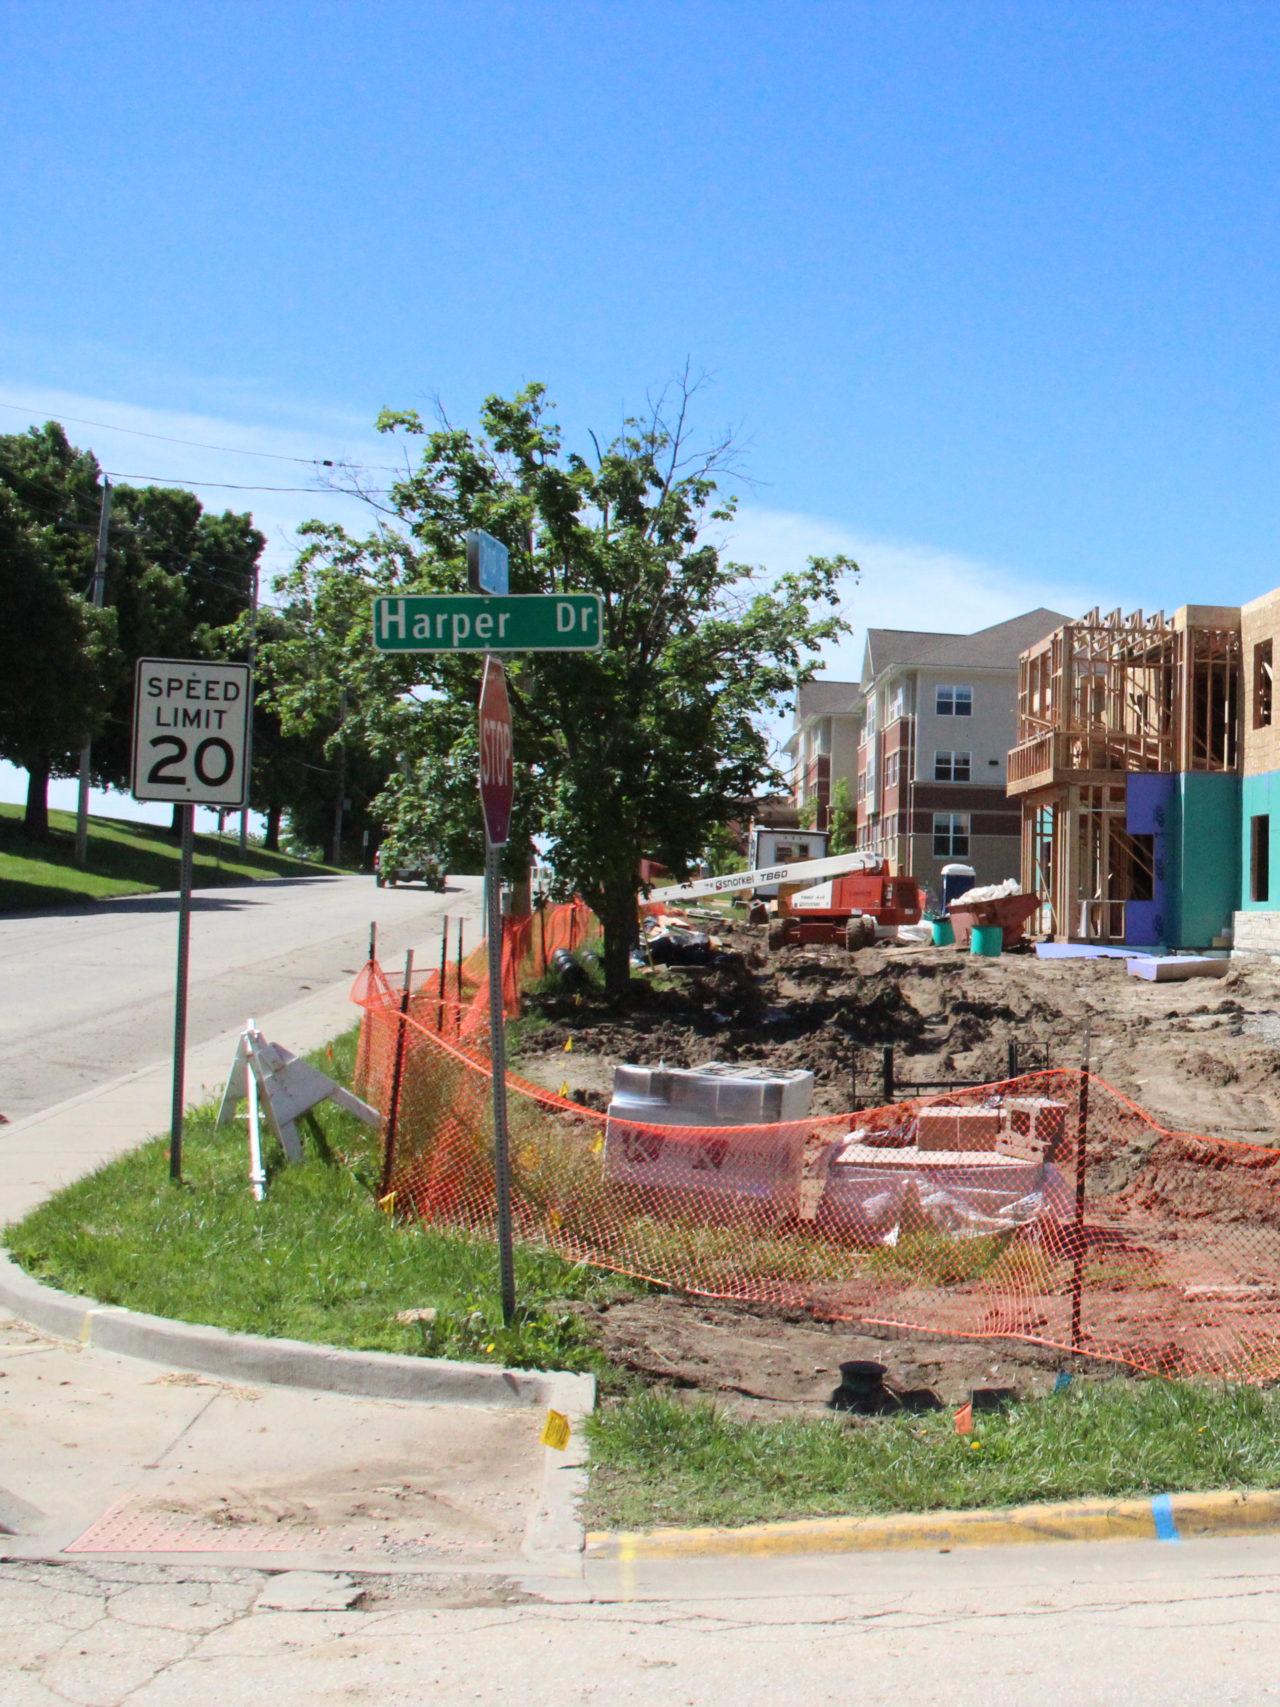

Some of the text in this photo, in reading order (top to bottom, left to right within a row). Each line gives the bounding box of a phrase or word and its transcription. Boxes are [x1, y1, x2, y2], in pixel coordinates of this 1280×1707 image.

[381, 600, 593, 647] Harper Dr
[147, 677, 240, 701] SPEED
[156, 706, 227, 730] LIMIT
[147, 735, 235, 787] 20
[483, 718, 511, 786] STOP
[760, 870, 788, 882] TB60
